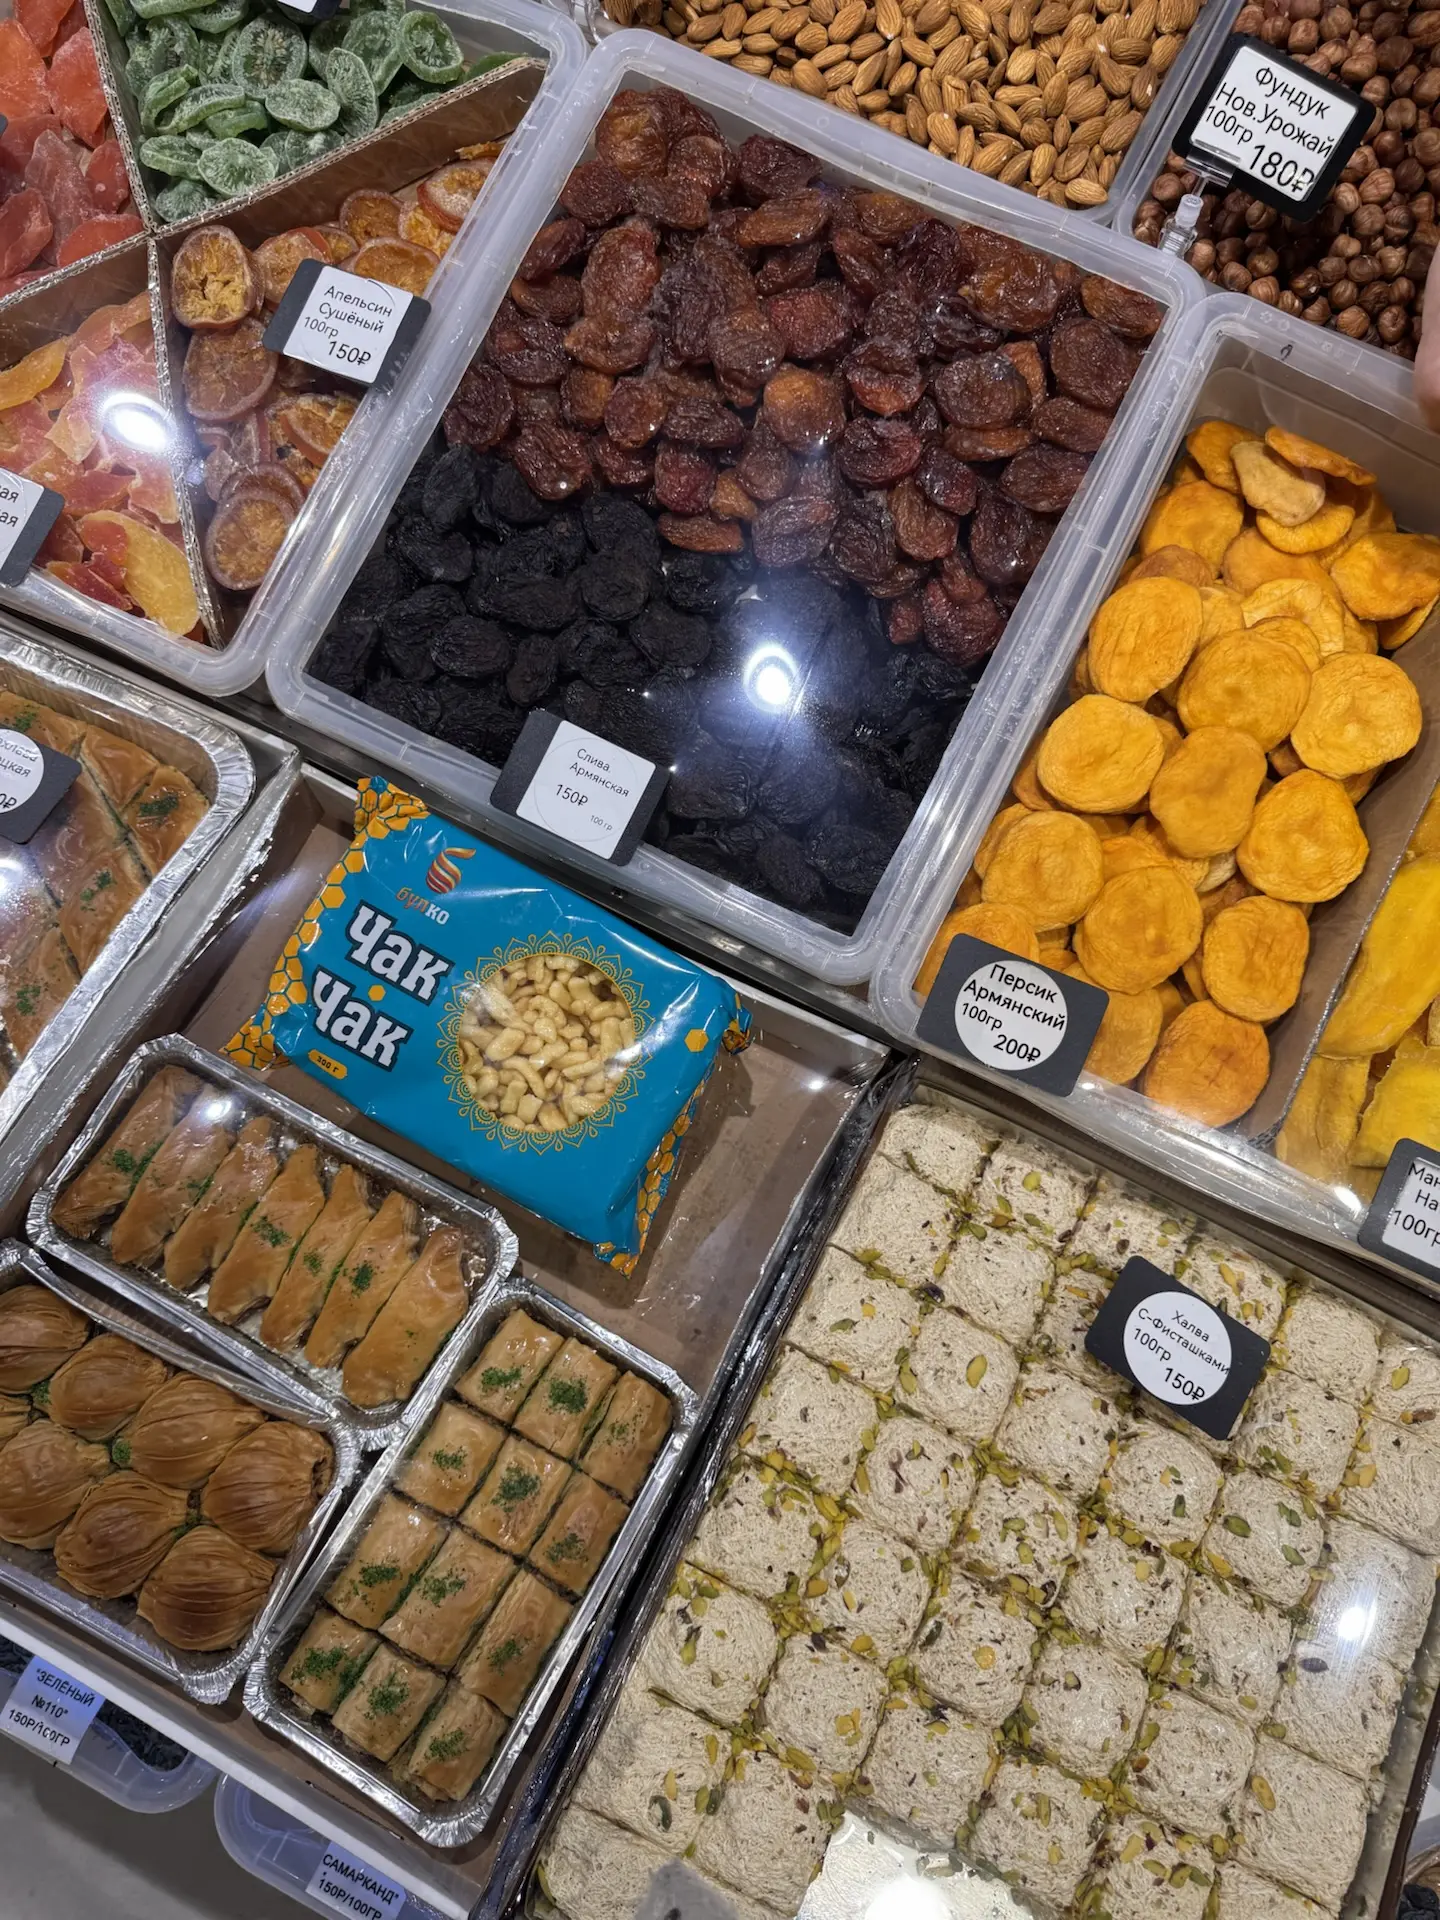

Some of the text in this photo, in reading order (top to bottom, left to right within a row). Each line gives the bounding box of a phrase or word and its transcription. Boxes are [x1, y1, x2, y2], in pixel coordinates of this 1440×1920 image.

[1255, 67, 1331, 120] Фундук
[1205, 105, 1254, 145] 100гр
[1215, 82, 1335, 159] Нов.Урожай
[324, 285, 393, 317] Апельсин
[304, 316, 339, 340] 100гр
[318, 302, 385, 334] Сушёный
[328, 341, 372, 366] 150₽
[0, 484, 19, 503] ая
[0, 509, 19, 527] ая
[0, 755, 31, 777] цкая
[569, 762, 630, 798] Армянская
[555, 784, 589, 807] 150₽
[590, 814, 613, 832] 100 гр
[348, 904, 451, 1002] Чак
[989, 964, 1058, 1003] Персик
[312, 968, 409, 1068] Чак
[962, 1002, 1003, 1031] 100гр
[963, 979, 1066, 1031] Армянский
[993, 1034, 1042, 1063] 200₽
[1171, 1310, 1210, 1342] Халва
[1133, 1328, 1172, 1362] 100гр
[1163, 1367, 1206, 1401] 150₽
